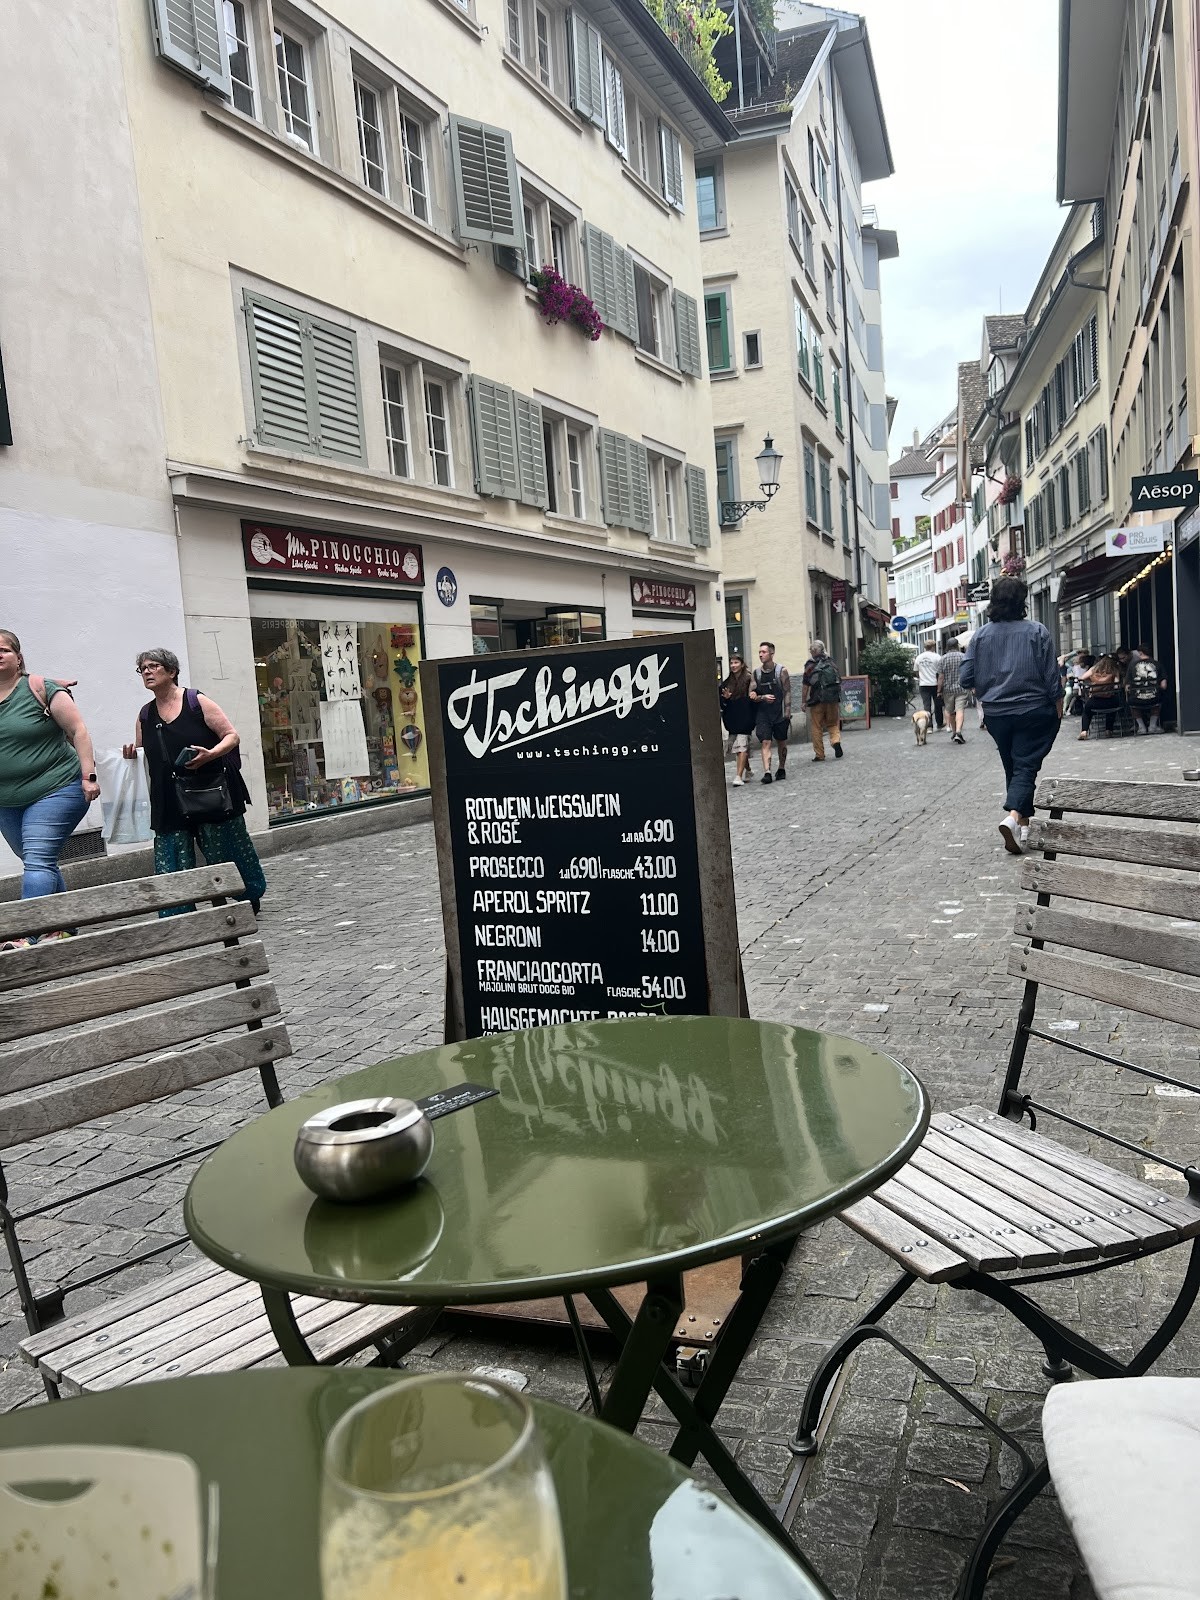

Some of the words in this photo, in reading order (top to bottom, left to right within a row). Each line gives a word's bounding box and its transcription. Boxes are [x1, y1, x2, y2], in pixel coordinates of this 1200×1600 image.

[309, 538, 401, 567] PINOCCHIO
[1129, 536, 1158, 545] LINGUIS
[651, 584, 686, 599] PINOCCHIO
[448, 653, 678, 759] Tschingg
[516, 743, 660, 760] www.tschingg.eu
[469, 855, 545, 879] PROSECCO
[602, 868, 635, 880] FLASCHE
[633, 855, 677, 879] 43.00
[472, 890, 533, 914] APEROL
[536, 890, 591, 914] SPRITZ
[639, 892, 679, 916] 11.00
[474, 924, 542, 948] NEGRONI
[640, 928, 680, 953] 14.00
[478, 981, 516, 993] MAJOLINI
[517, 983, 538, 994] BRUT
[539, 984, 560, 995] DOCG
[561, 985, 576, 995] BIO
[606, 986, 641, 998] FLASCHE
[641, 975, 687, 999] 54.00
